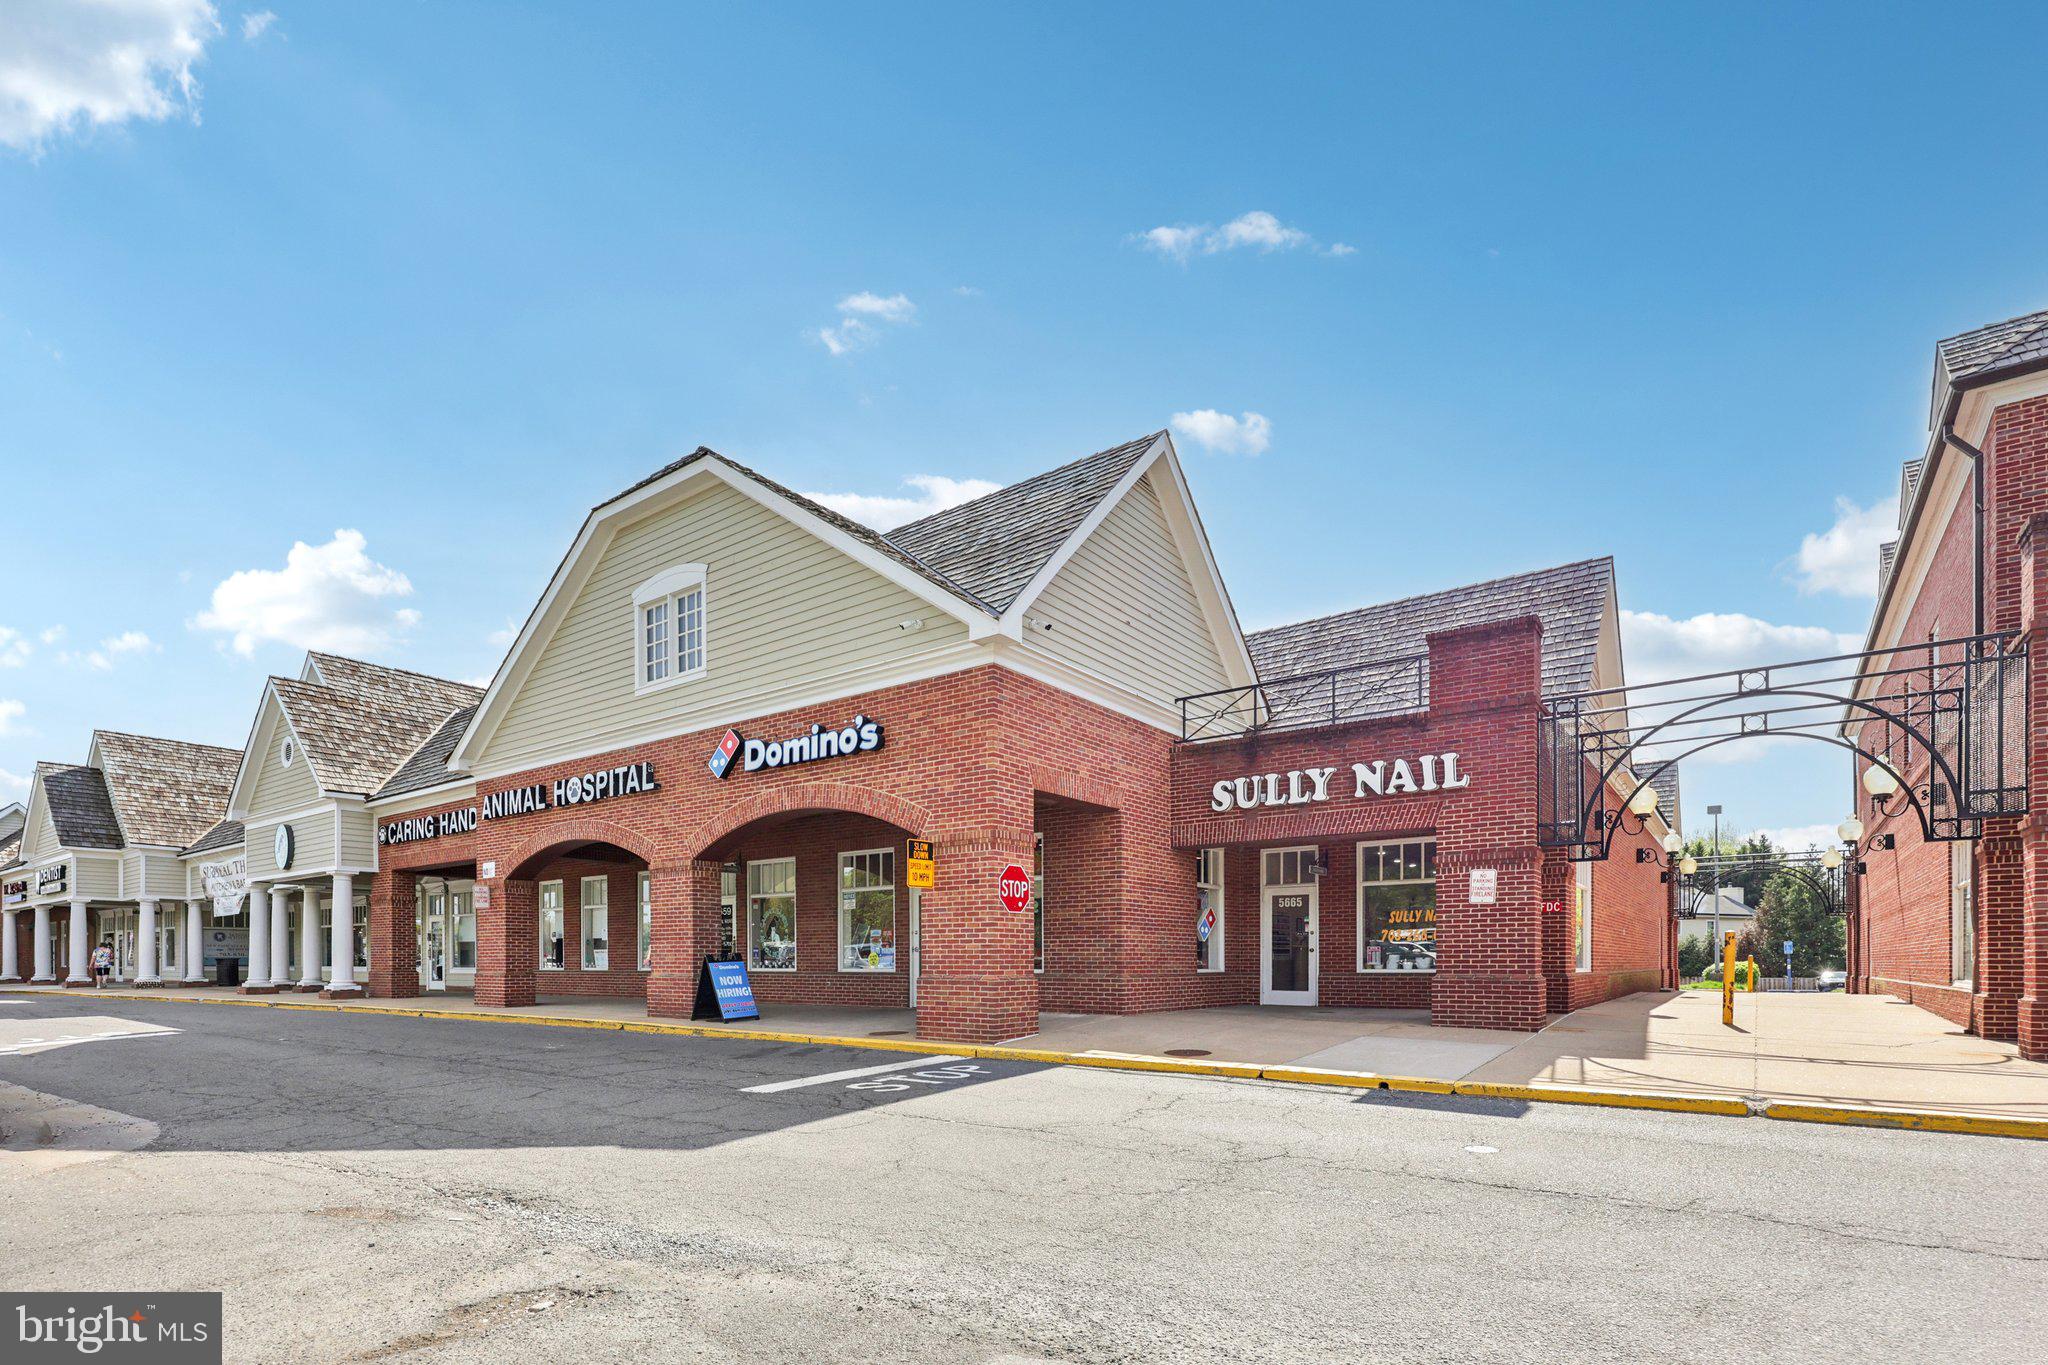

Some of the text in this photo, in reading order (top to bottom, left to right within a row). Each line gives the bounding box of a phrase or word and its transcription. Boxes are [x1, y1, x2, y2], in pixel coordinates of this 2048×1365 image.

[744, 714, 879, 772] Domino's
[1211, 752, 1470, 812] SULLY NAIL
[387, 761, 655, 844] CARING HAND ANIMAL HOSPITAL
[913, 842, 929, 851] SLOW
[913, 851, 929, 860] DOWN
[1001, 879, 1029, 898] STOP
[1278, 897, 1303, 908] 5665
[1540, 901, 1561, 912] FDC
[1389, 909, 1423, 924] SULLY
[719, 975, 743, 986] NOW
[717, 986, 753, 998] HIRING!
[845, 1065, 992, 1092] STOP
